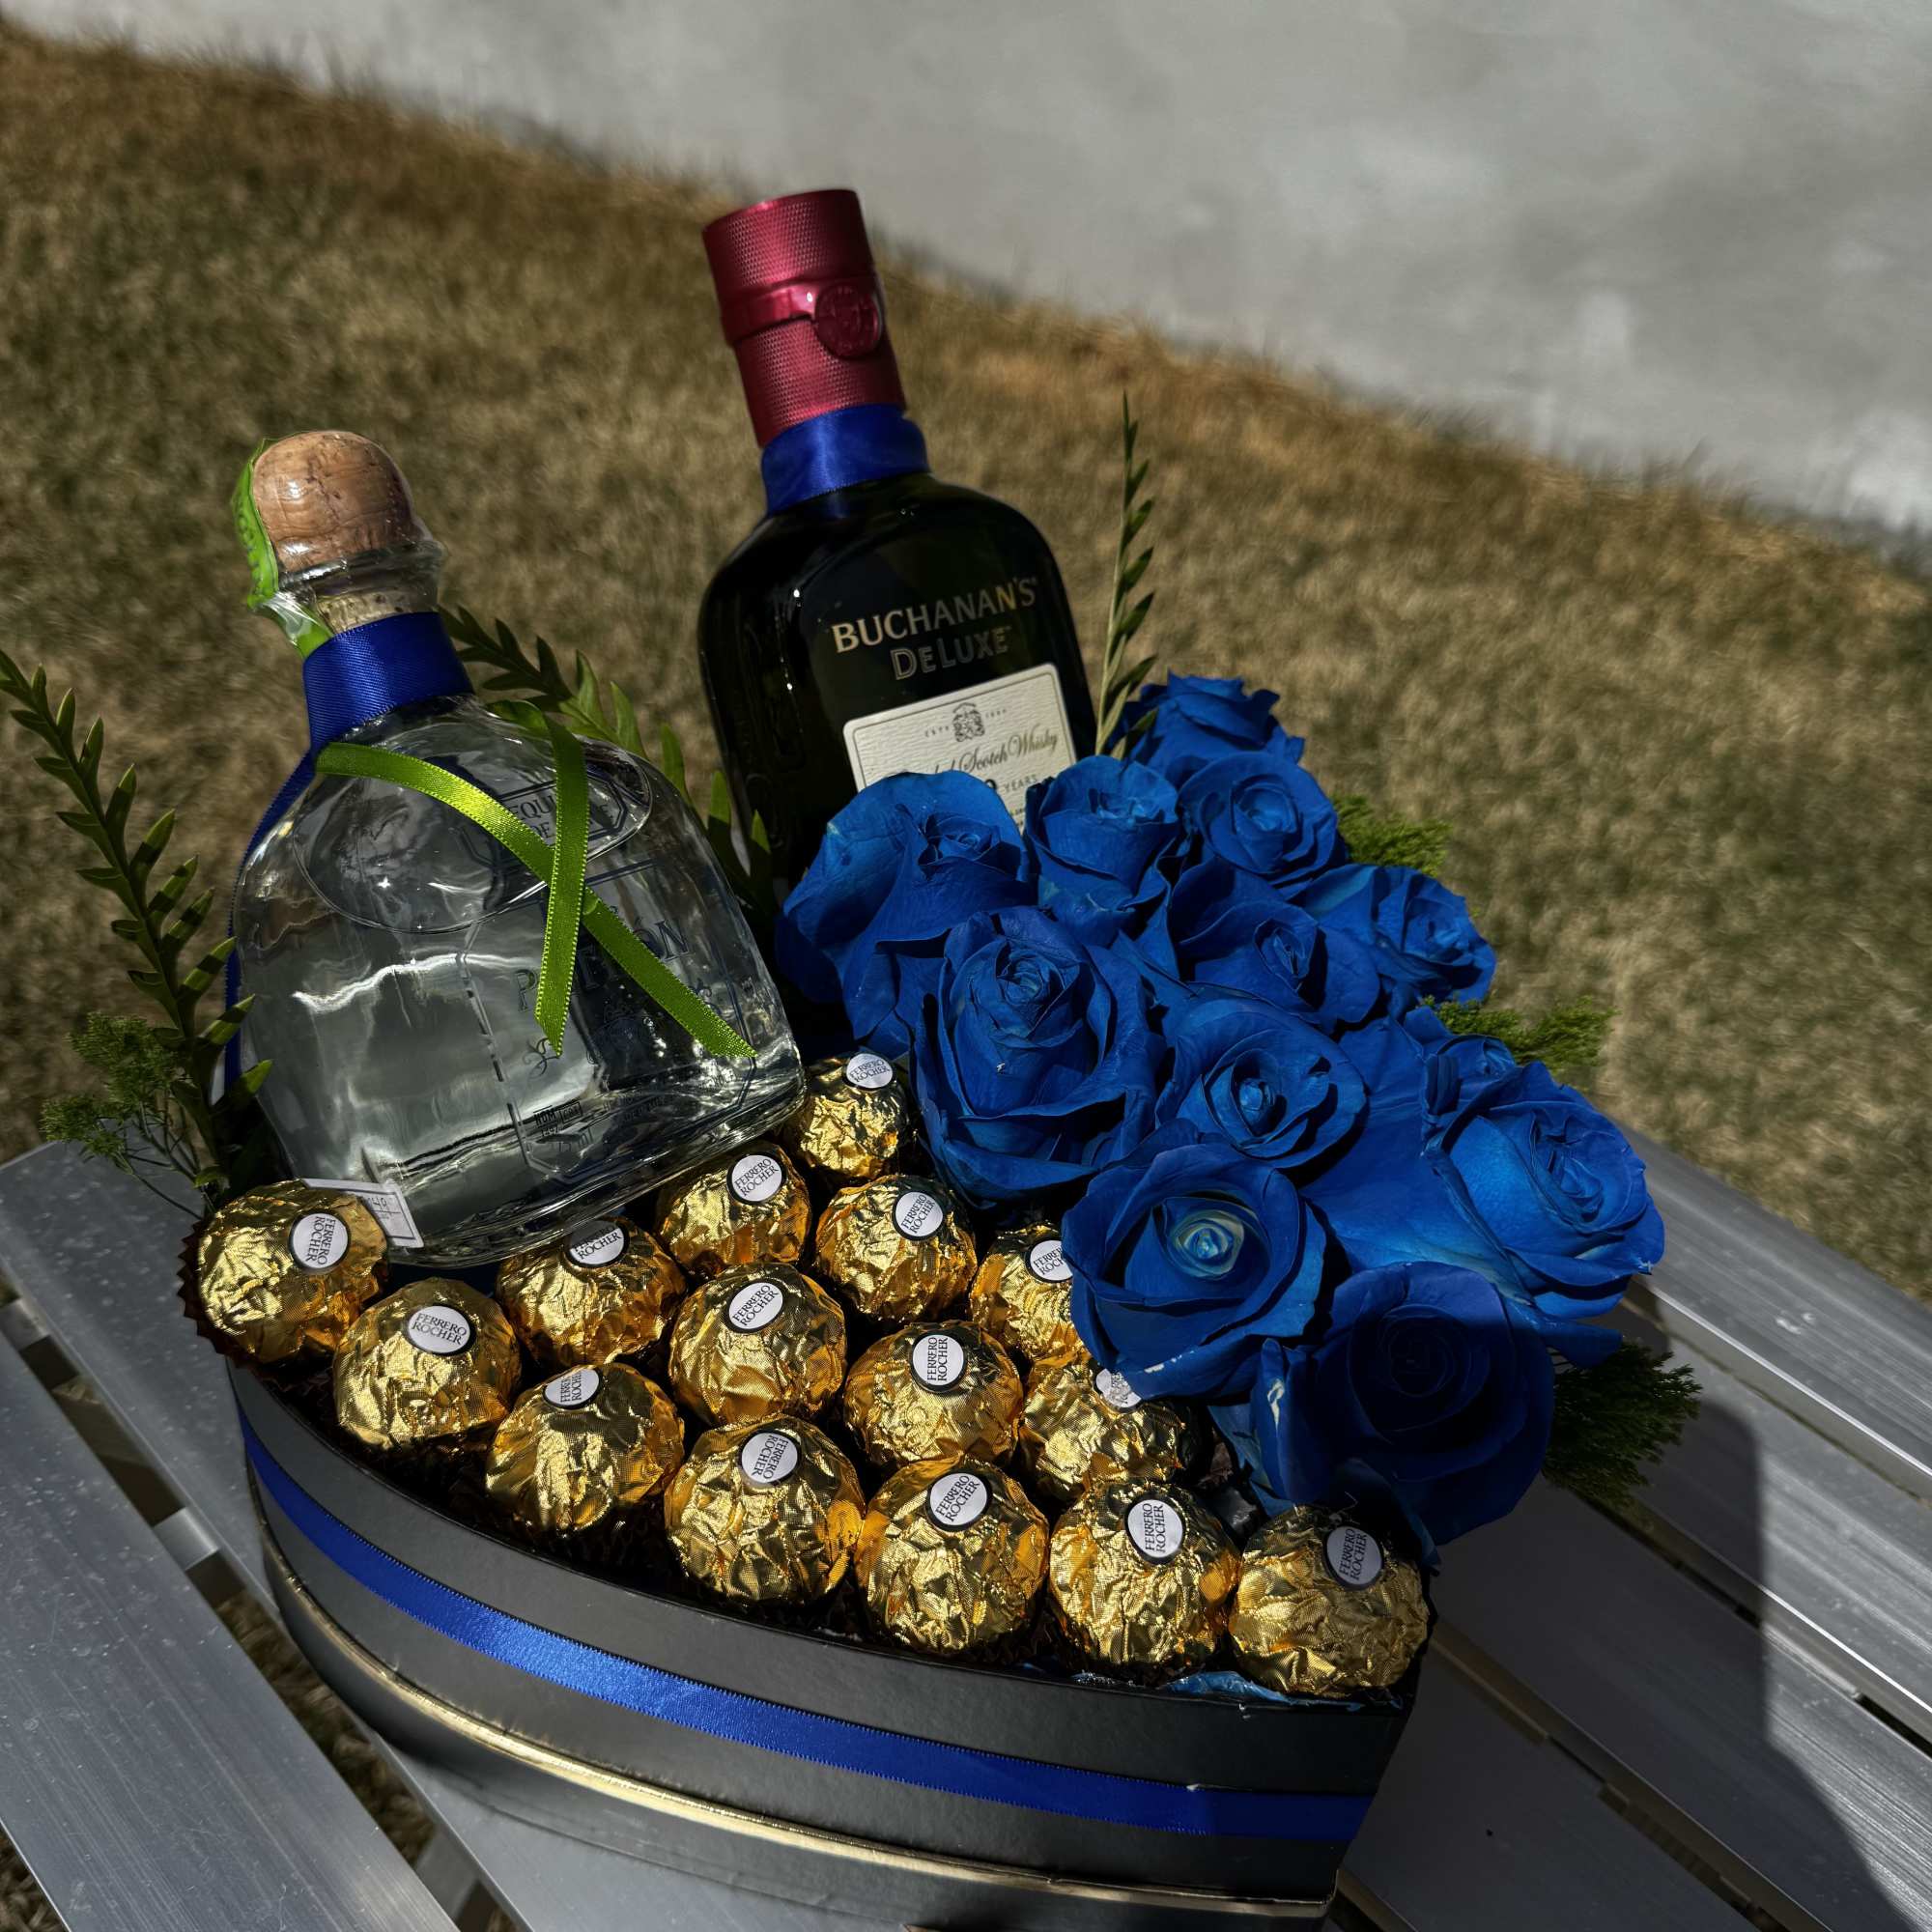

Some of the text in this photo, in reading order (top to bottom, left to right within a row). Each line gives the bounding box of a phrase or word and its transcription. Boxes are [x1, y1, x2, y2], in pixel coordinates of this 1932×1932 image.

[832, 577, 1037, 653] BUCHANAN'S
[959, 747, 1009, 774] Scotch
[1008, 723, 1058, 758] Whisky
[1005, 775, 1037, 792] YEARS
[850, 1059, 885, 1078] FERRERO
[855, 1065, 891, 1083] ROCHER
[734, 1158, 772, 1189] FERRERO
[739, 1165, 779, 1196] ROCHER
[901, 1194, 926, 1229] FERRERO
[909, 1199, 935, 1234] ROCHER
[305, 1216, 326, 1262] ROCHER
[317, 1218, 336, 1264] FERRERO
[578, 1232, 623, 1260] ROCHER
[732, 1285, 771, 1321] FERRERO
[740, 1290, 779, 1325] ROCHER
[412, 1321, 462, 1346] ROCHER
[416, 1313, 467, 1336] FERRERO
[926, 1337, 938, 1380] FERRERO
[937, 1337, 948, 1381] ROCHER
[751, 1435, 779, 1476] ROCHER
[763, 1438, 788, 1479] FERRERO
[935, 1475, 970, 1517] FERRERO
[945, 1481, 980, 1522] ROCHER
[1142, 1503, 1155, 1551] FERRERO
[1152, 1504, 1166, 1553] ROCHER
[1339, 1528, 1356, 1575] FERRERO
[1350, 1533, 1367, 1580] ROCHER
